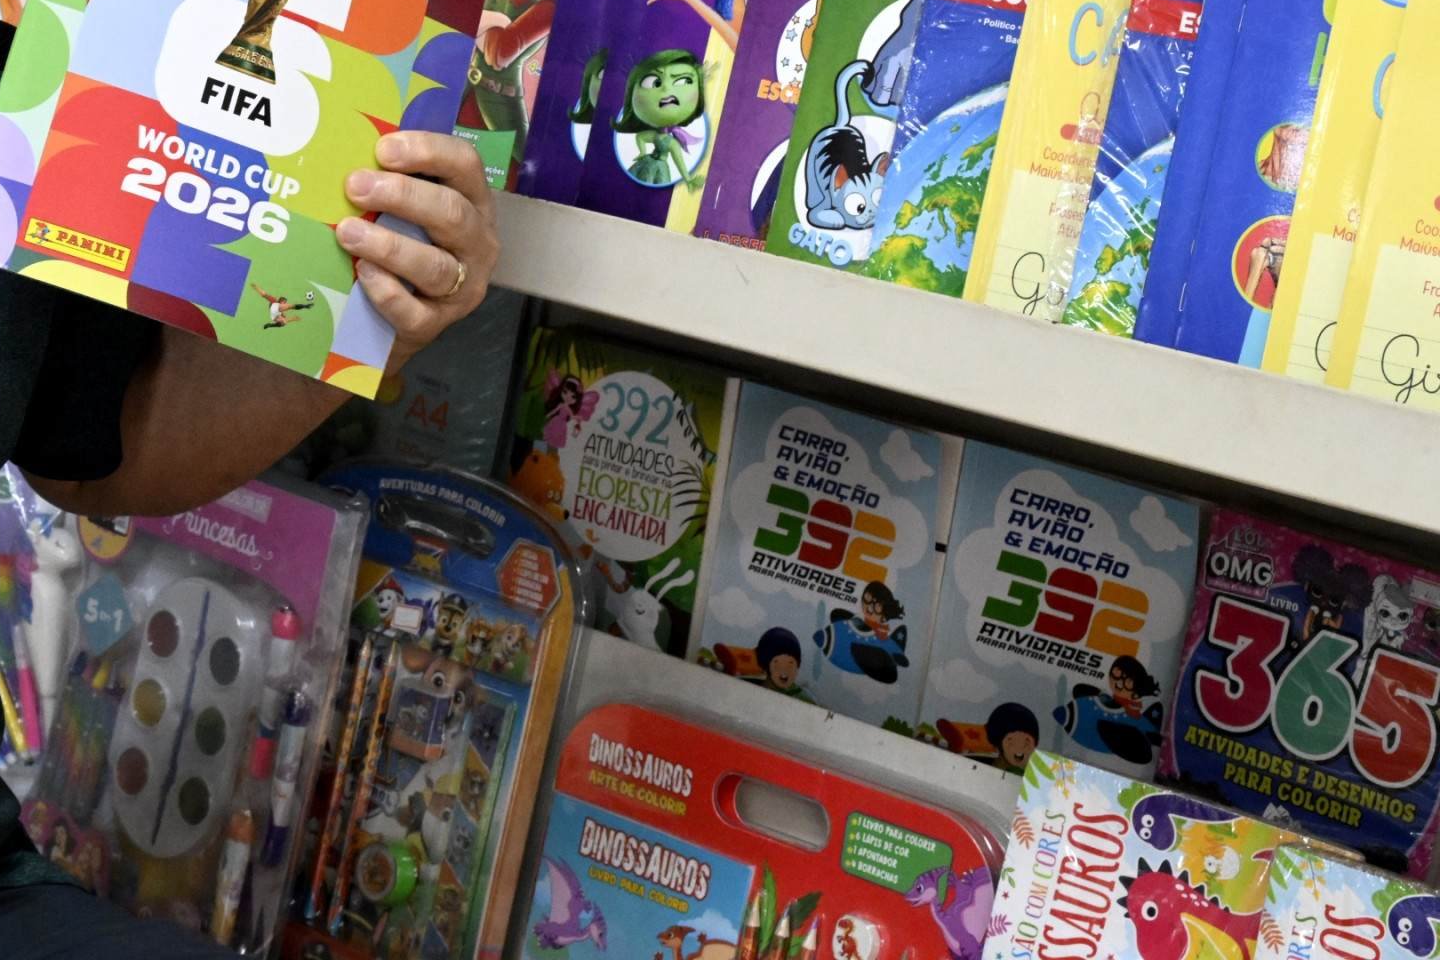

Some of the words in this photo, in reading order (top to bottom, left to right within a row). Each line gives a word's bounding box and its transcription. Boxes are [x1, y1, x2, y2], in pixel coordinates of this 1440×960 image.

[200, 77, 273, 128] FIFA
[137, 124, 241, 180] WORLD
[245, 165, 301, 200] CUP
[120, 156, 291, 244] 2026
[57, 229, 125, 262] PANINI
[787, 222, 853, 266] GATO
[406, 394, 449, 431] A4
[598, 381, 675, 449] 392
[584, 432, 675, 477] ATIVIDADES
[776, 444, 842, 476] AVIÃO
[778, 424, 851, 463] CARRO,
[379, 477, 436, 499] AVENTURAS
[578, 465, 673, 520] FLORESTA
[774, 464, 789, 482] &
[794, 471, 881, 509] EMOÇÃO
[1009, 487, 1094, 529] CARRO,
[572, 494, 667, 546] ENCANTADA
[753, 483, 897, 585] 392
[1007, 509, 1085, 543] AVIÃO
[751, 551, 857, 595] ATIVIDADES
[1004, 530, 1023, 548] &
[1028, 537, 1130, 579] EMOÇÃO
[748, 563, 775, 581] PARA
[775, 571, 809, 591] PINTAR
[816, 583, 858, 605] BRINCAR
[981, 549, 1149, 657] 392
[1270, 596, 1299, 612] LIVRO
[975, 635, 1007, 651] PARA
[1007, 642, 1046, 663] PINTAR
[1056, 657, 1105, 681] BRINCAR
[979, 621, 1103, 669] ATIVIDADES
[1195, 594, 1440, 789] 365
[588, 732, 693, 798] DINOSSAUROS
[1184, 724, 1295, 780] ATIVIDADES
[1296, 765, 1310, 784] E
[1313, 770, 1417, 823] DESENHOS
[588, 769, 619, 793] ARTE
[619, 778, 634, 797] DE
[634, 783, 688, 817] COLORIR
[1223, 762, 1274, 798] PARA
[1277, 781, 1363, 828] COLORIR
[857, 847, 898, 869] APONTADOR
[862, 817, 884, 834] LIVRO
[885, 826, 904, 841] PARA
[904, 834, 937, 853] COLORIR
[883, 841, 893, 852] DE
[894, 846, 910, 858] COR
[1032, 809, 1066, 877] CORES
[579, 816, 713, 902] DINOSSAUROS
[588, 866, 620, 888] LIVRO
[621, 876, 646, 899] PARA
[647, 884, 690, 914] COLORIR
[1024, 879, 1049, 919] COM
